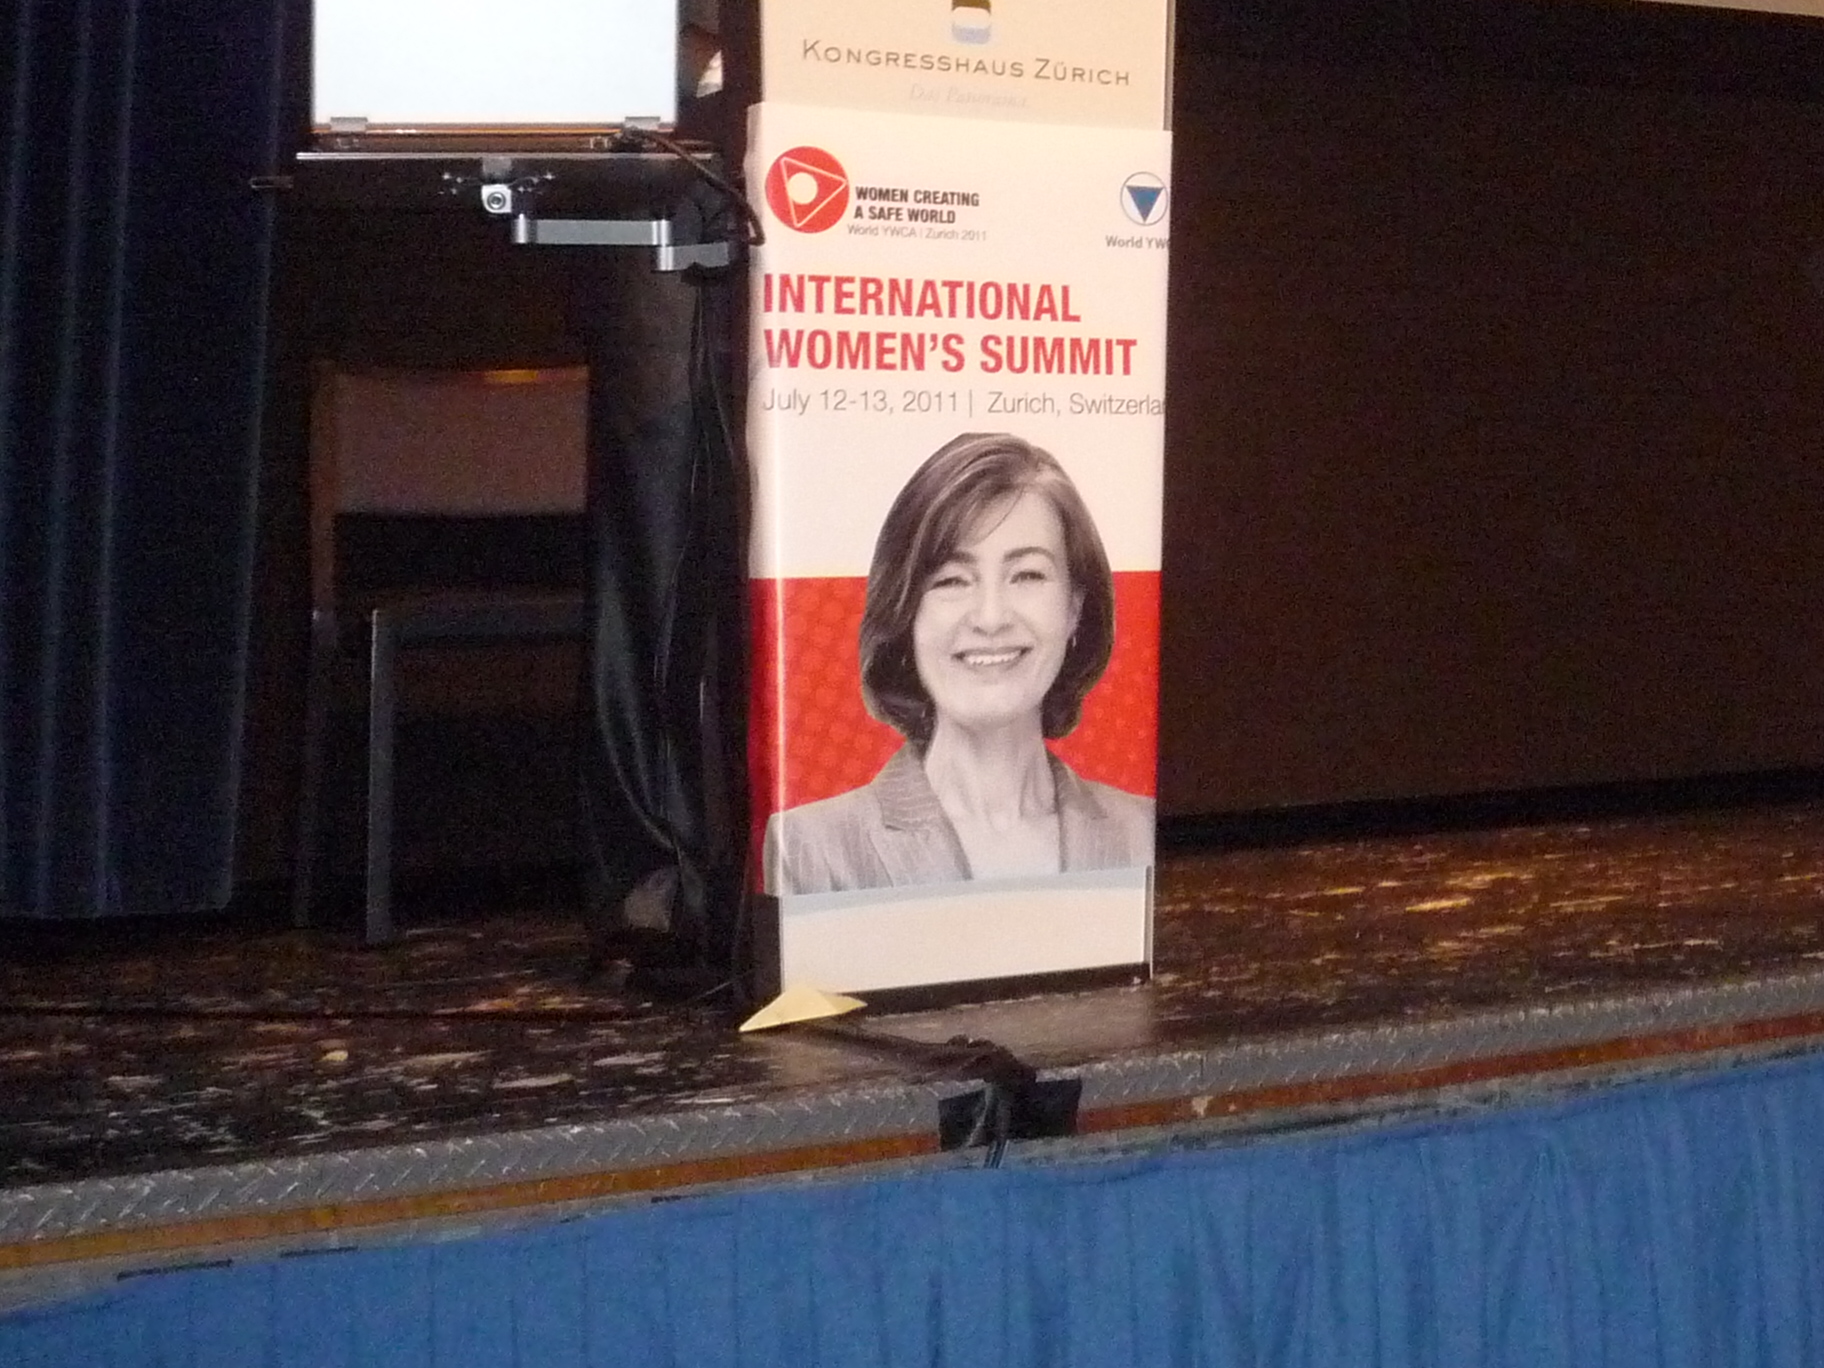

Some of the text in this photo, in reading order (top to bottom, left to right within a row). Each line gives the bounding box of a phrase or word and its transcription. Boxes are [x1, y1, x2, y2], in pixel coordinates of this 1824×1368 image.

[855, 186, 980, 207] WOMEN CREATING
[853, 205, 956, 224] A SAFE WORLD
[847, 224, 879, 236] World
[882, 225, 917, 238] YWCA
[1105, 235, 1170, 249] World YW
[763, 273, 1082, 323] INTERNATIONAL
[763, 328, 1138, 376] WOMEN'S SUMMIT
[763, 388, 1167, 417] July 12-13, 2011 Zurich, Switzerla
